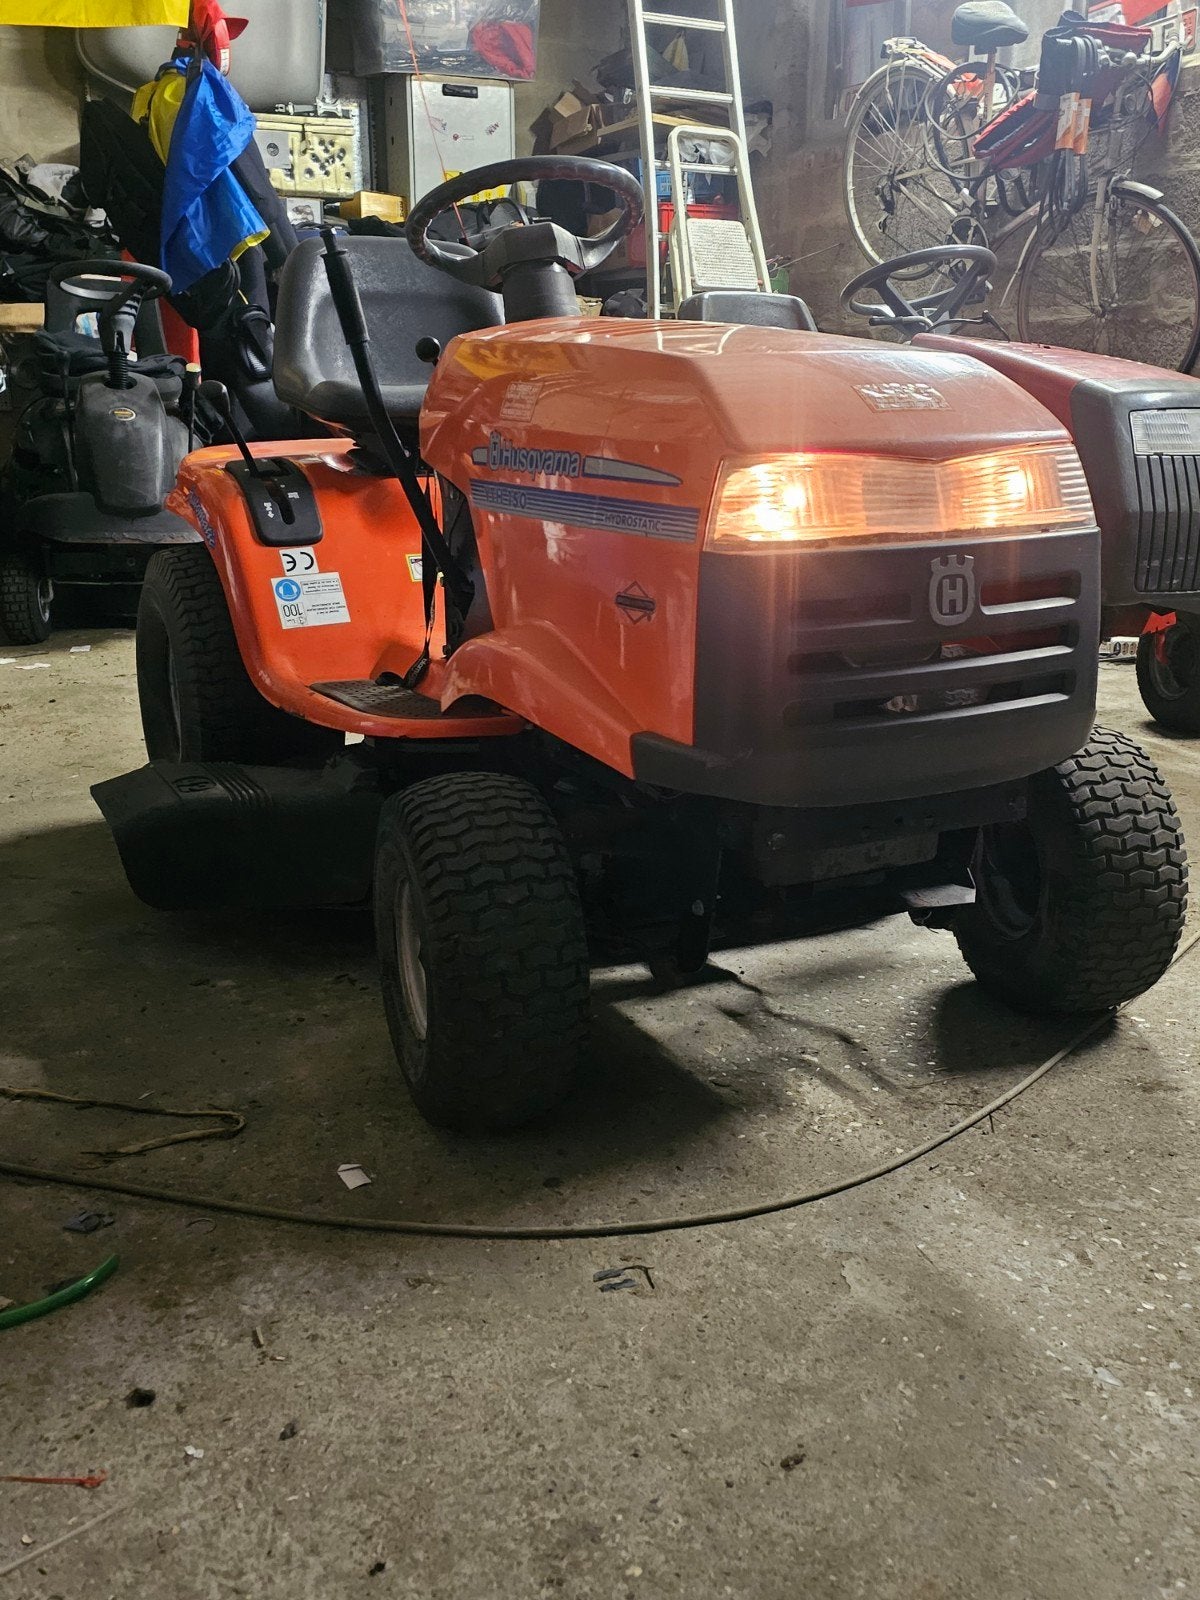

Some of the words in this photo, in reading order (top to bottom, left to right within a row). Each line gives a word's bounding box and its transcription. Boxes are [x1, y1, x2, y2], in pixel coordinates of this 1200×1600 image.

[502, 439, 582, 480] Husqvarna
[604, 513, 662, 531] HYDROSTATIC
[282, 603, 304, 617] 100
